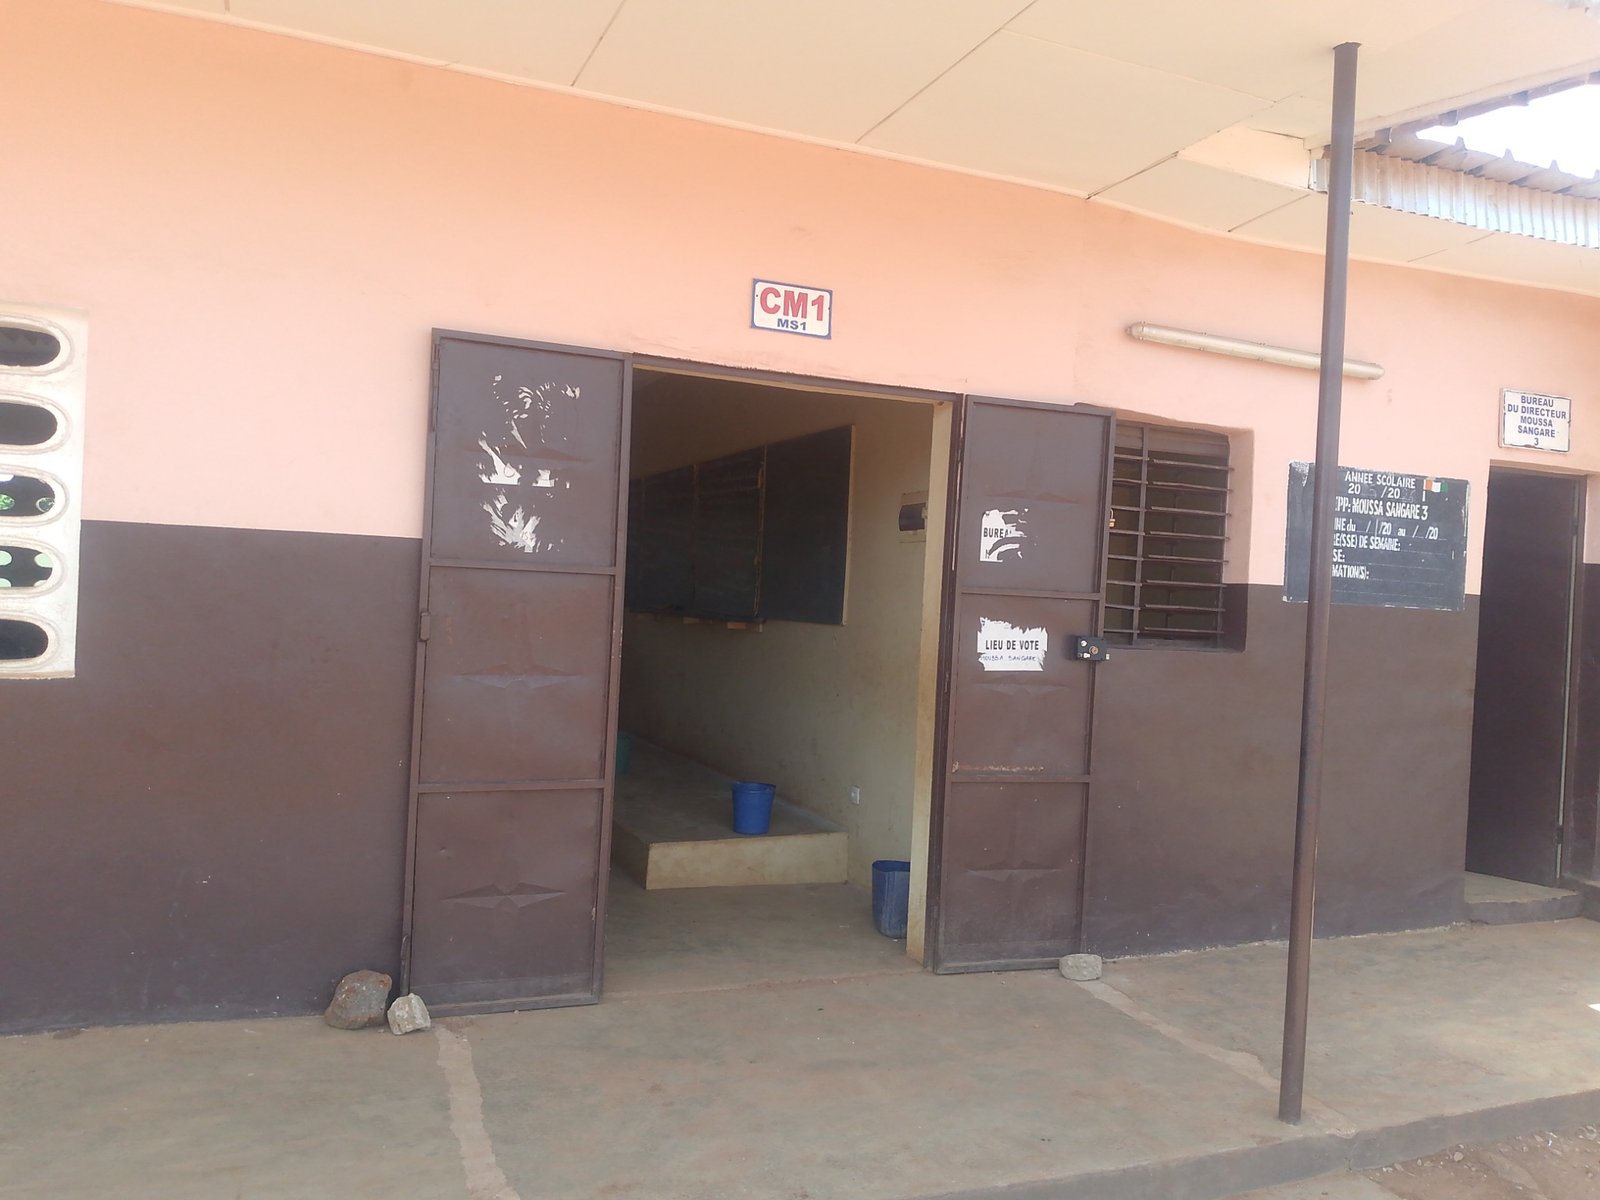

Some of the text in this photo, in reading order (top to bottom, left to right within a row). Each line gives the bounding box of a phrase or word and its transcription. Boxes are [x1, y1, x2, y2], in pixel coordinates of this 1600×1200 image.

[759, 286, 825, 321] CM1
[777, 318, 807, 331] MS1
[1520, 395, 1554, 408] BUREAU
[1507, 403, 1567, 420] DU DIRECTEUR
[1520, 415, 1553, 428] MOUSSA
[1517, 425, 1556, 438] SANGARE
[1534, 437, 1539, 446] 3
[1344, 470, 1416, 489] ANNEE SCOLAIRE
[1352, 498, 1384, 516] MOUSSA
[1385, 501, 1421, 520] SANGARE
[1421, 505, 1428, 521] 3
[1346, 518, 1356, 532] du
[1397, 527, 1406, 537] au
[1358, 536, 1369, 549] DE
[985, 639, 1039, 650] LIEU DE VOTE
